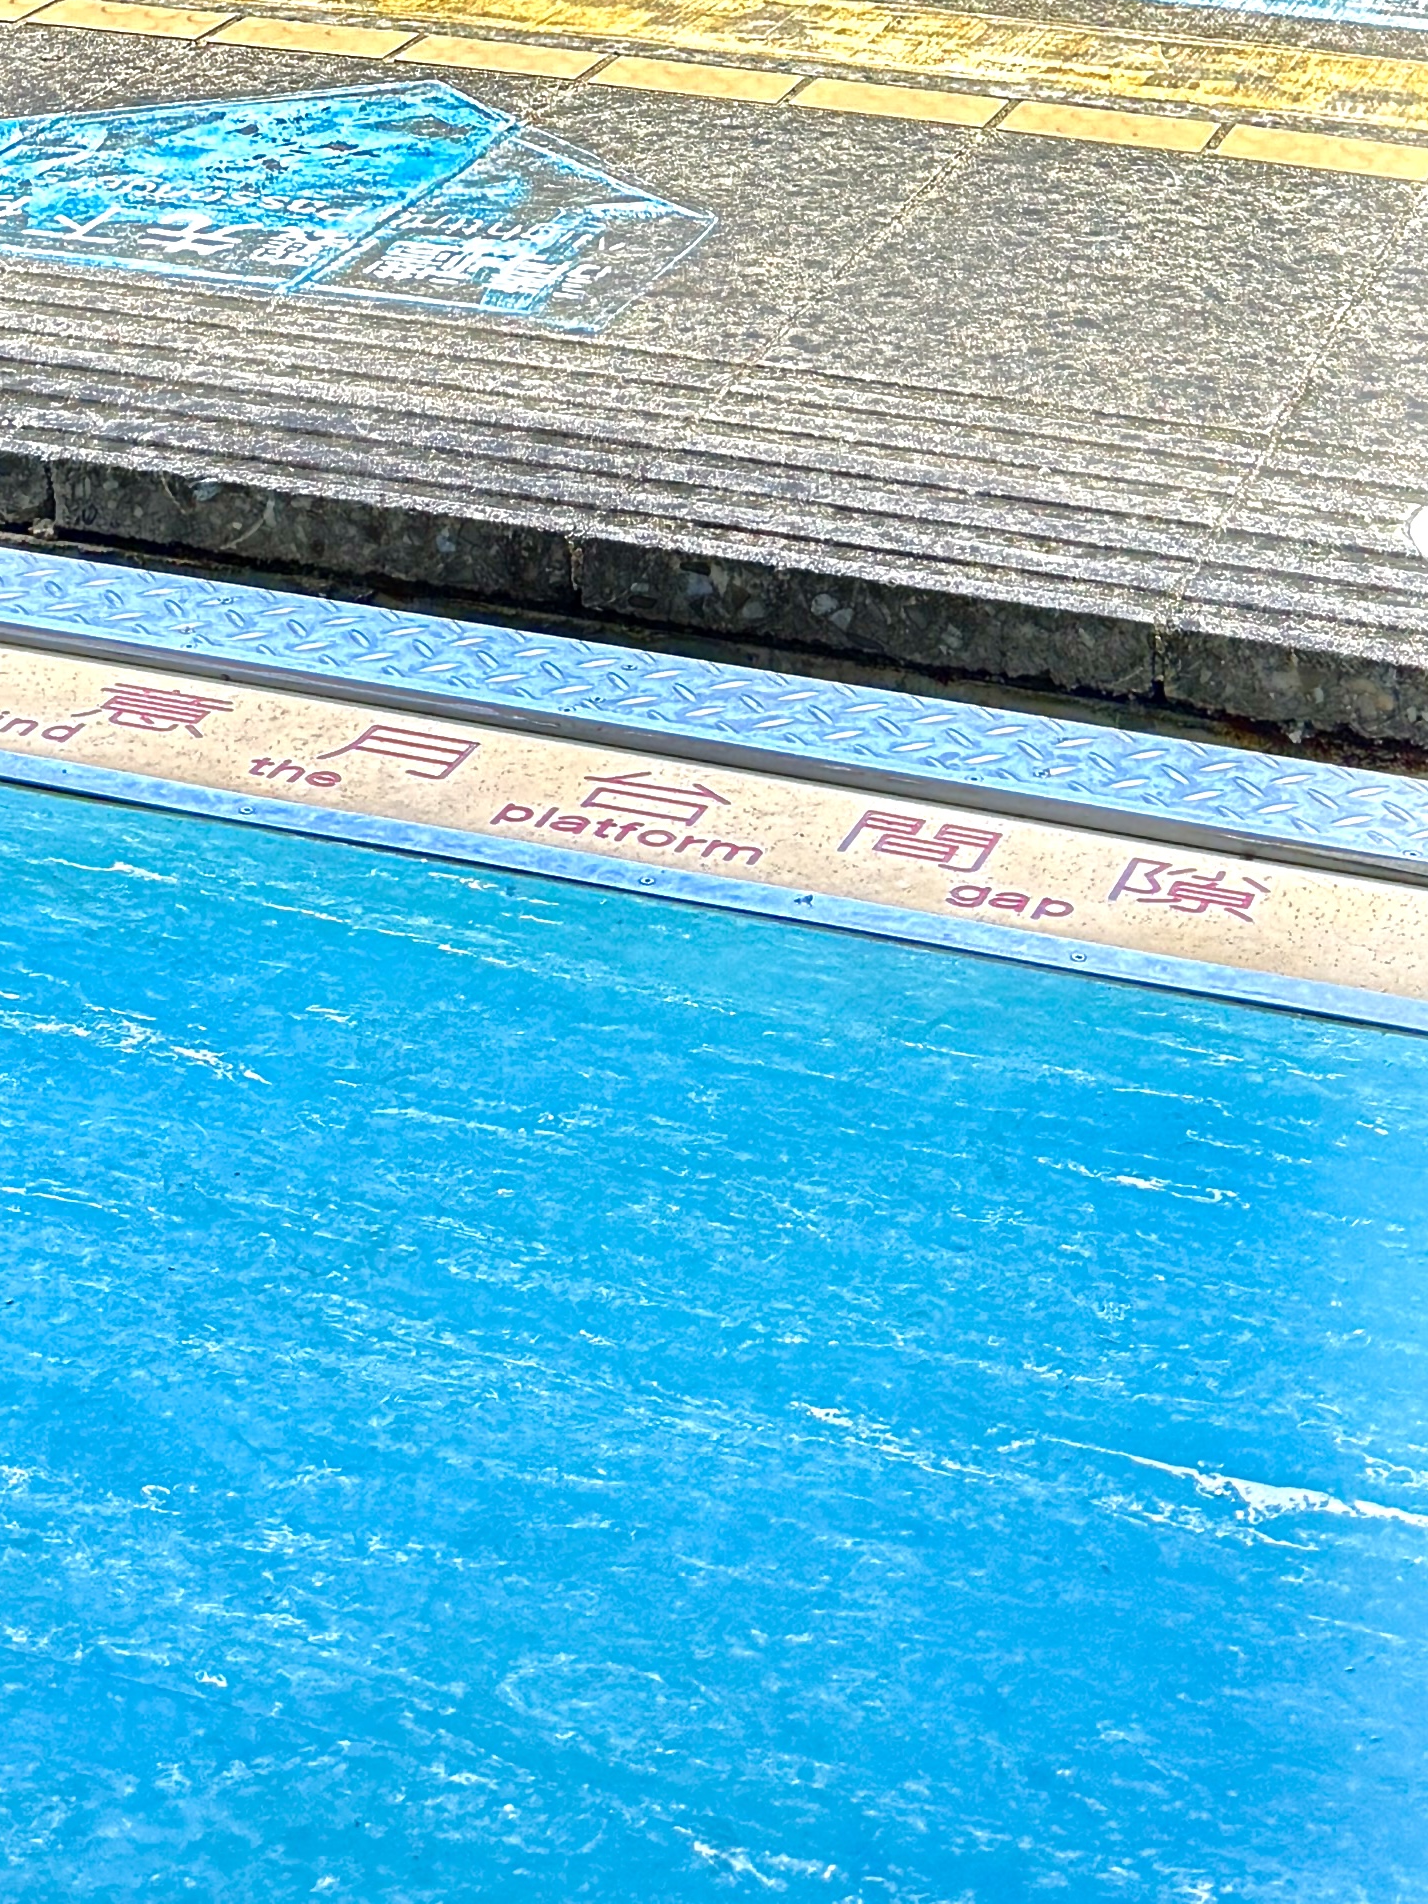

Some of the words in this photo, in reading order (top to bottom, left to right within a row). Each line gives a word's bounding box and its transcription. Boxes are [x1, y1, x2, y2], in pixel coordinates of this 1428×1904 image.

[247, 756, 345, 789] the
[489, 800, 766, 867] platform
[944, 882, 1077, 920] gap
